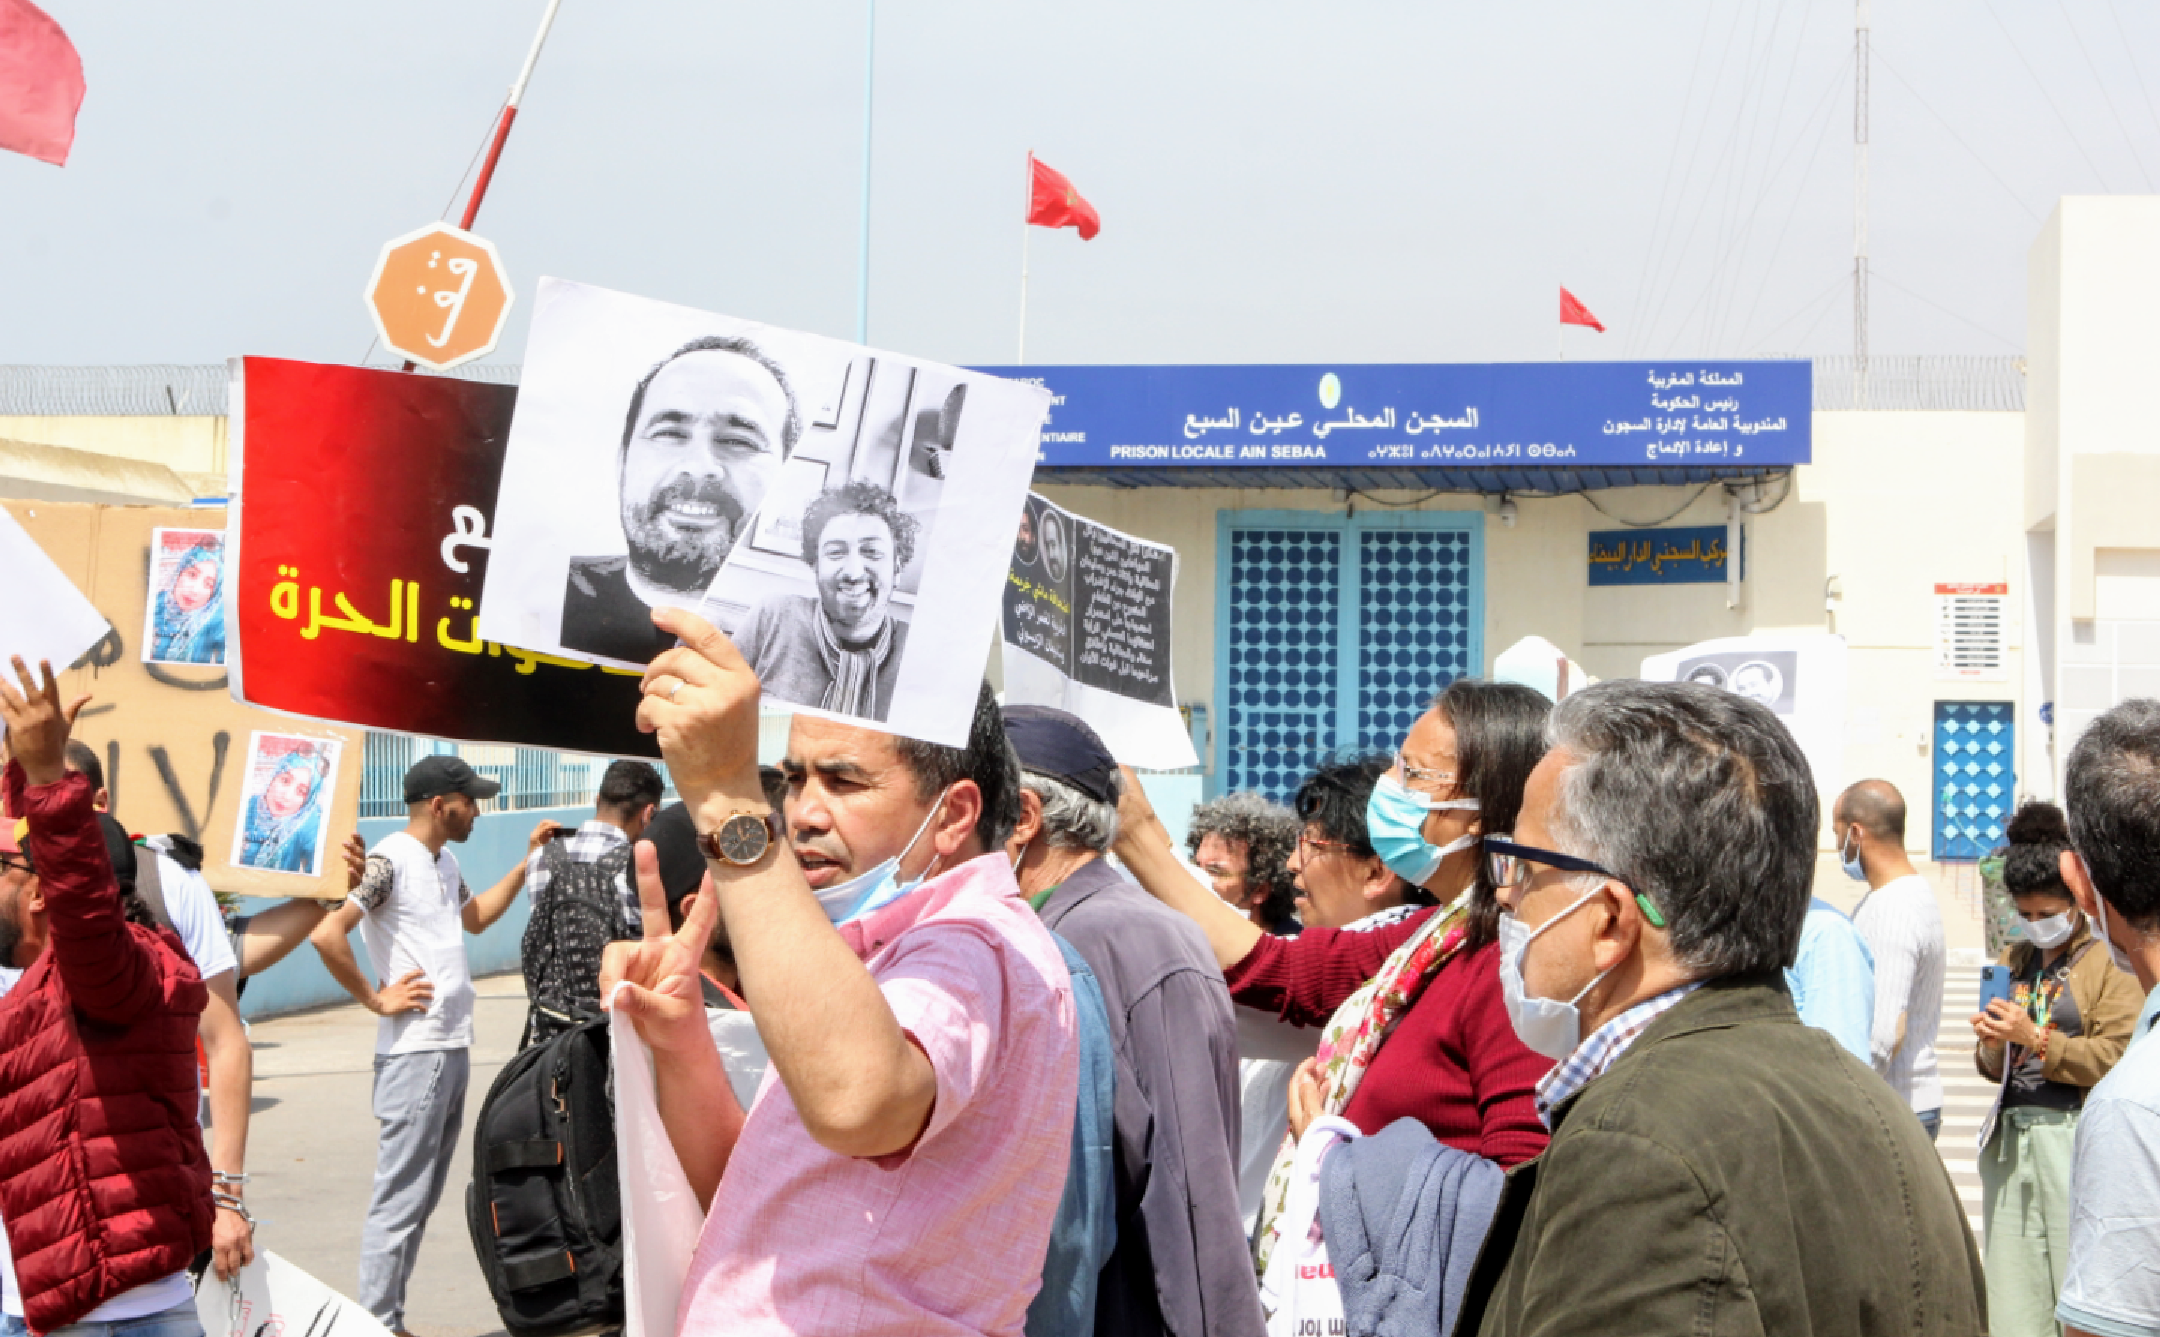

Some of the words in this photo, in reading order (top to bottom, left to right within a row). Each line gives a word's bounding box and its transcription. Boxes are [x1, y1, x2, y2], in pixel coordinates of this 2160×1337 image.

[1647, 369, 1694, 390] المغربية
[1697, 370, 1743, 386] المملكة
[1650, 393, 1700, 412] الحكومة
[1704, 395, 1739, 412] رئيس
[1184, 406, 1241, 439] السبع
[1248, 411, 1304, 436] عين
[1312, 406, 1397, 439] المحلي
[1404, 406, 1479, 435] السجن
[1602, 417, 1652, 435] السجون
[1041, 432, 1086, 443] NTIAIRE
[1110, 445, 1169, 460] PRISON
[1171, 445, 1235, 460] LOCALE
[1239, 445, 1267, 460] AIN
[1271, 445, 1327, 460] SEBAA
[269, 565, 420, 643] الحرة
